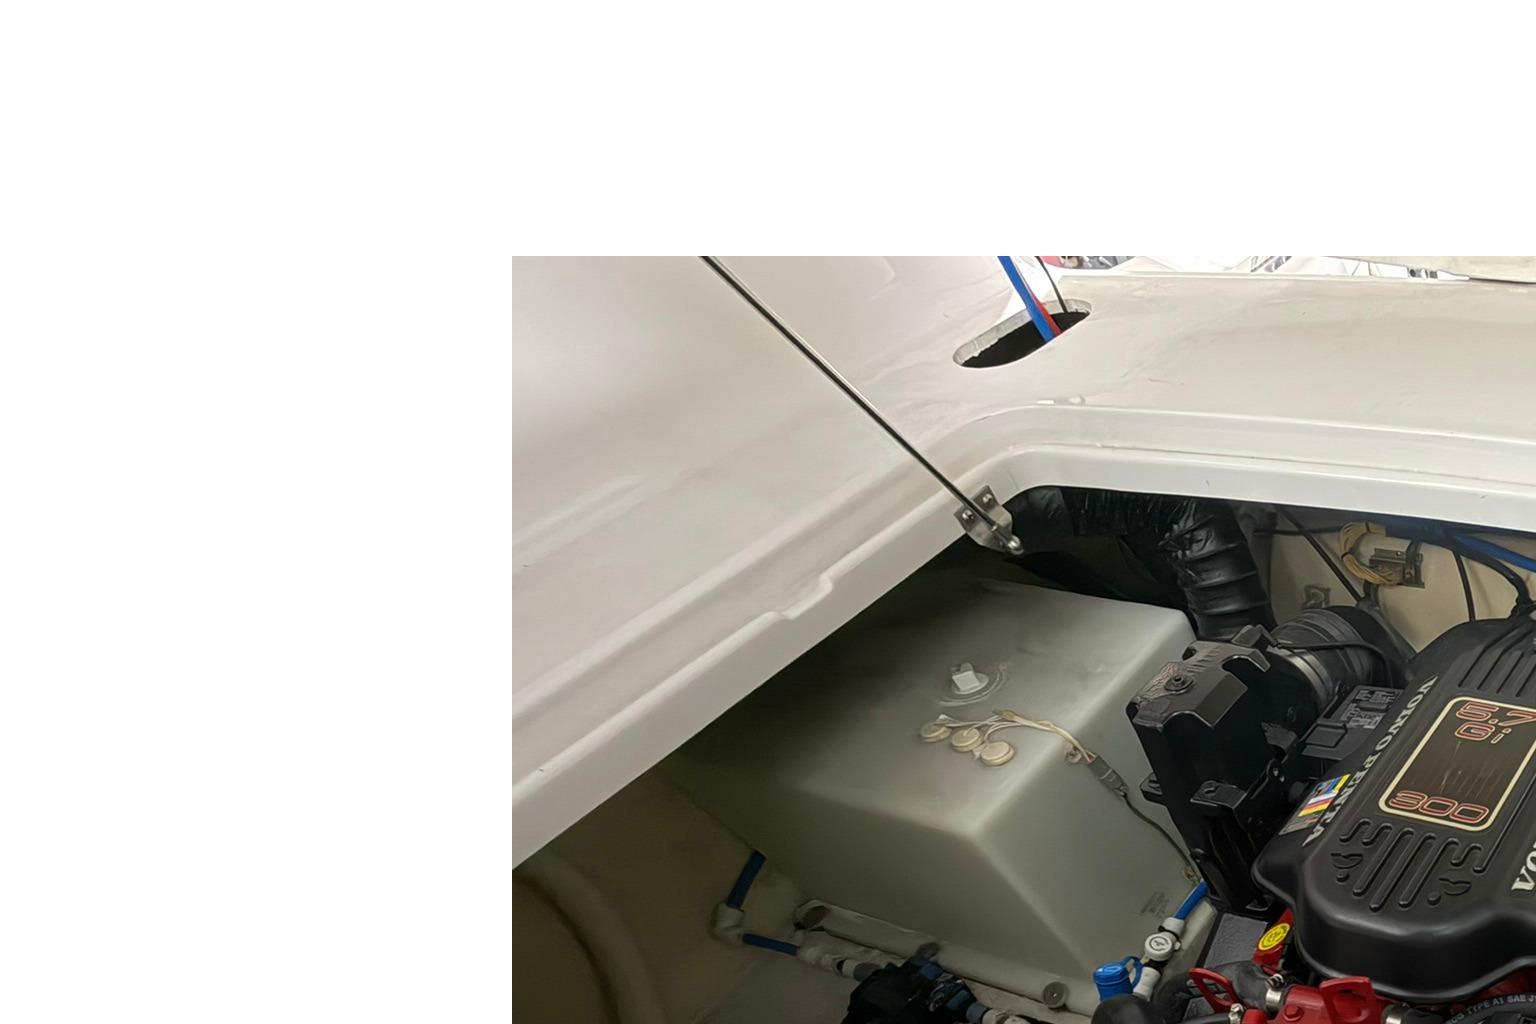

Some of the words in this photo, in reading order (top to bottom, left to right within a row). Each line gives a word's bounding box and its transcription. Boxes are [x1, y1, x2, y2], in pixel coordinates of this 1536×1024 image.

[1375, 675, 1438, 750] VOLVO
[1454, 722, 1512, 744] Gi
[1388, 790, 1490, 824] 300
